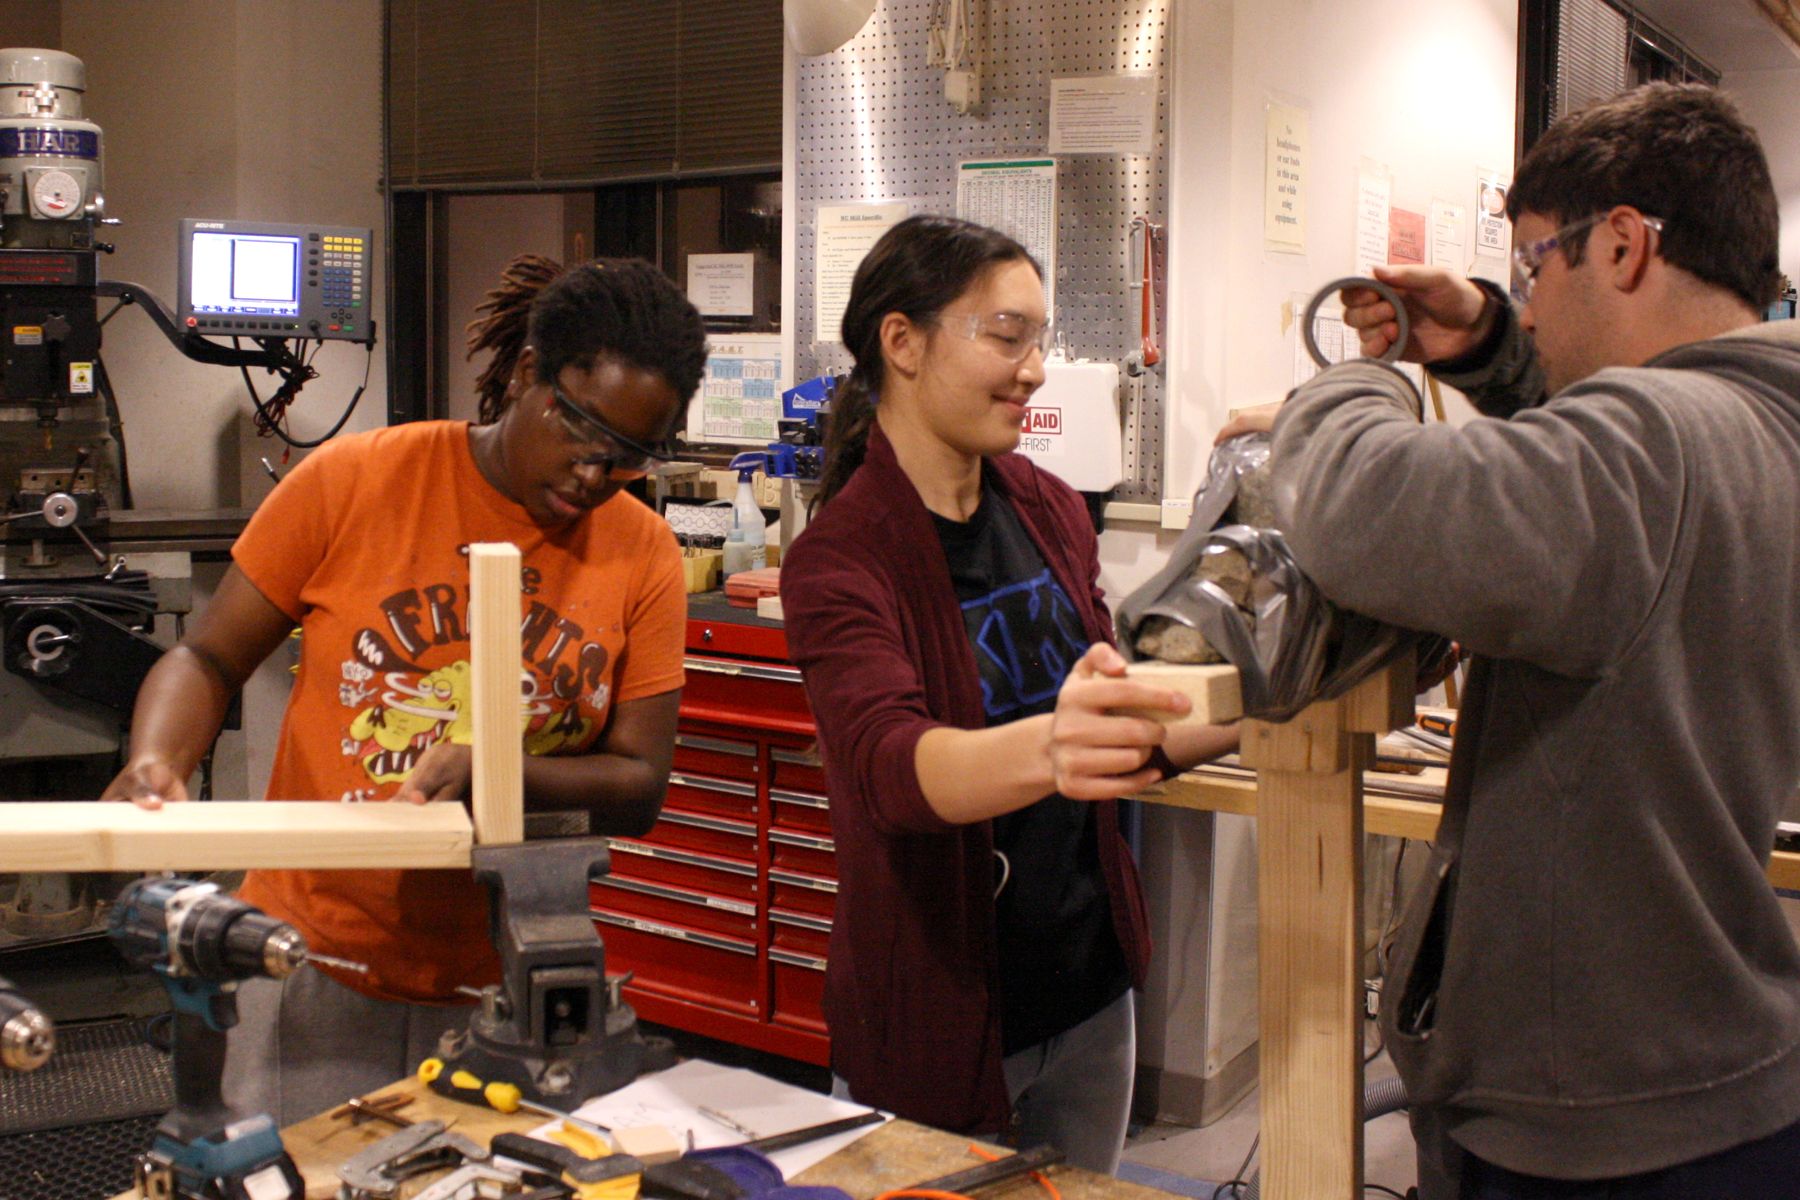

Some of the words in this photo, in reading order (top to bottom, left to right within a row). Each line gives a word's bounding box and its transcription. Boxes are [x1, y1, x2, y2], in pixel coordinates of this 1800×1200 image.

[8, 131, 90, 154] HAR
[1033, 412, 1058, 430] AID
[1018, 437, 1051, 453] -FIRST
[380, 584, 609, 700] FRHTS
